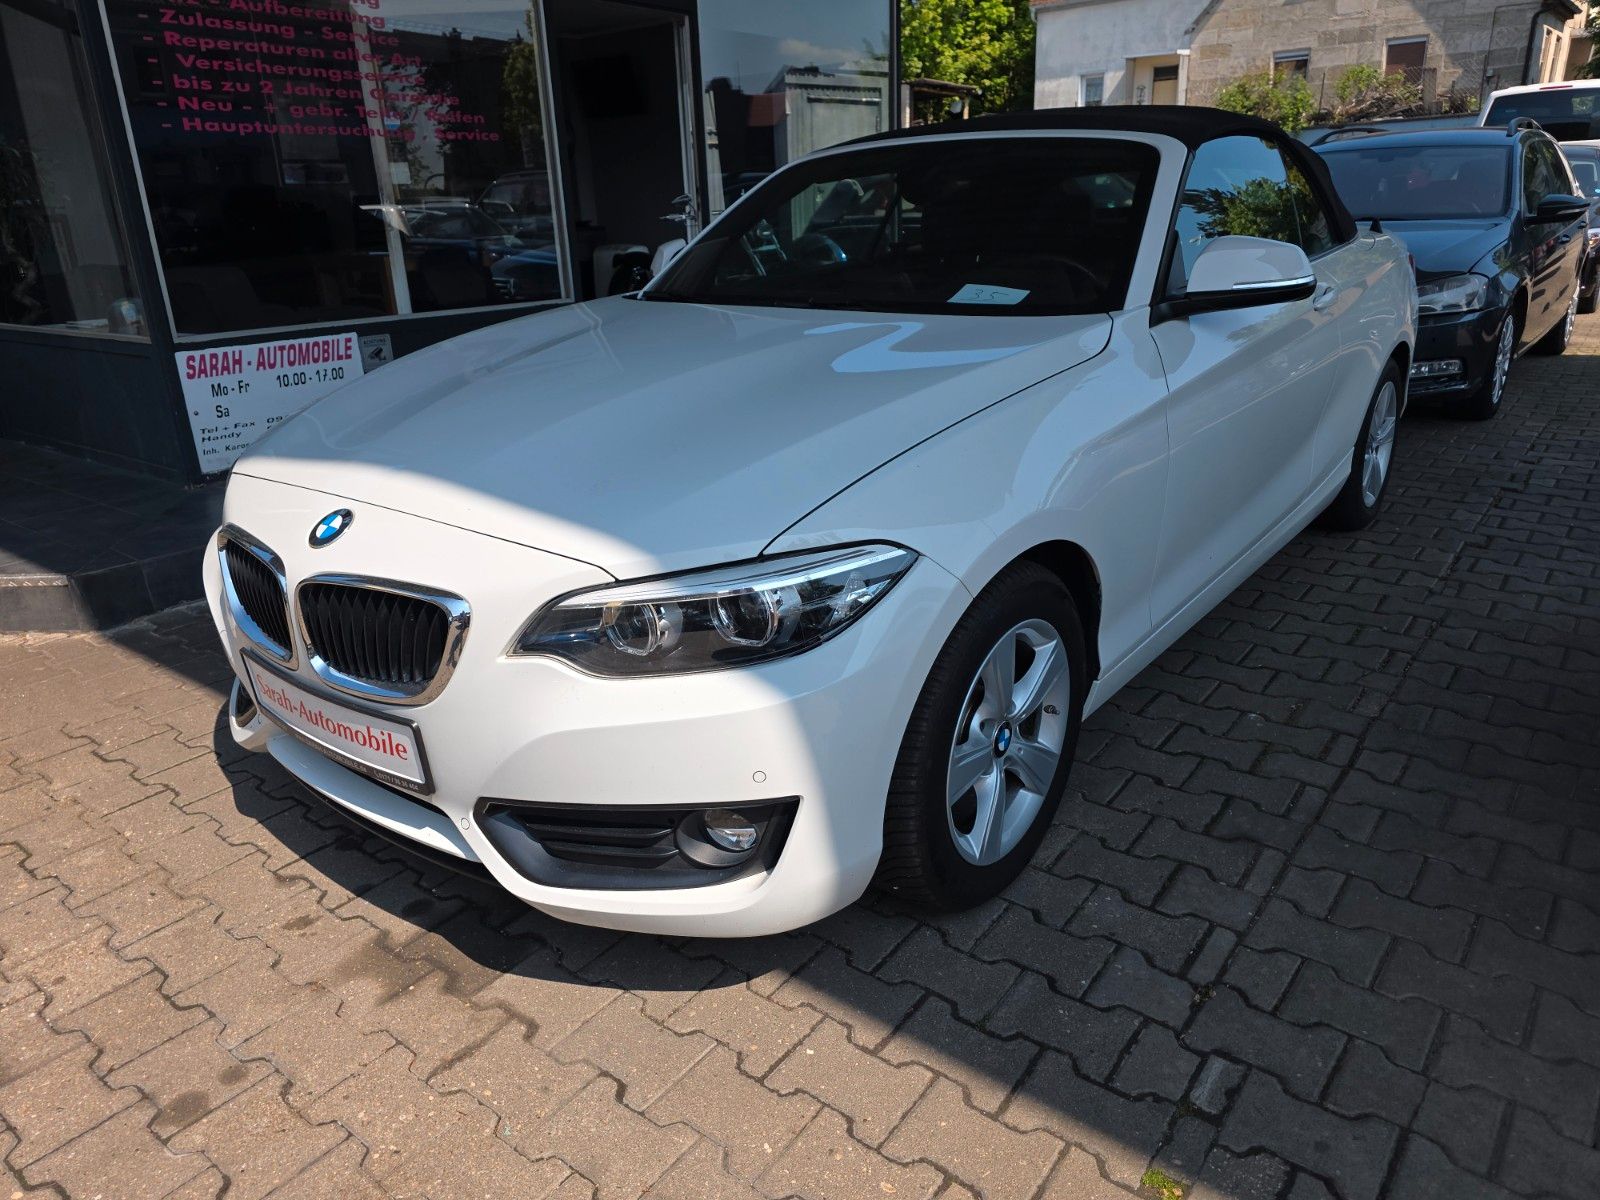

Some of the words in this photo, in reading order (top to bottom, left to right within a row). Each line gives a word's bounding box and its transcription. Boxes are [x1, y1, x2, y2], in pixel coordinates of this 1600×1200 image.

[229, 0, 385, 29] Aufbereitung
[159, 8, 296, 39] Zulassung
[321, 26, 400, 46] Service
[163, 30, 325, 58] Reperaturen
[332, 47, 382, 63] aller
[389, 53, 423, 67] Art
[176, 53, 426, 86] Versicherungsservice
[172, 73, 213, 91] bis
[220, 81, 251, 92] zu
[259, 80, 274, 94] 2
[283, 82, 362, 100] Jahren
[177, 96, 233, 112] Neu
[289, 102, 348, 118] gebr.
[434, 127, 500, 142] Service
[186, 349, 243, 380] SARAH
[256, 337, 353, 371] AUTOMOBILE
[276, 371, 307, 388] 10.00
[315, 366, 345, 383] 17.00
[211, 382, 229, 398] Mo
[238, 379, 250, 394] Fr
[215, 404, 230, 419] Sa
[200, 426, 218, 435] Tel
[234, 421, 256, 429] Fax
[201, 431, 242, 443] Handy
[203, 447, 220, 456] Inh.
[256, 673, 408, 761] Sarah-Automobile
